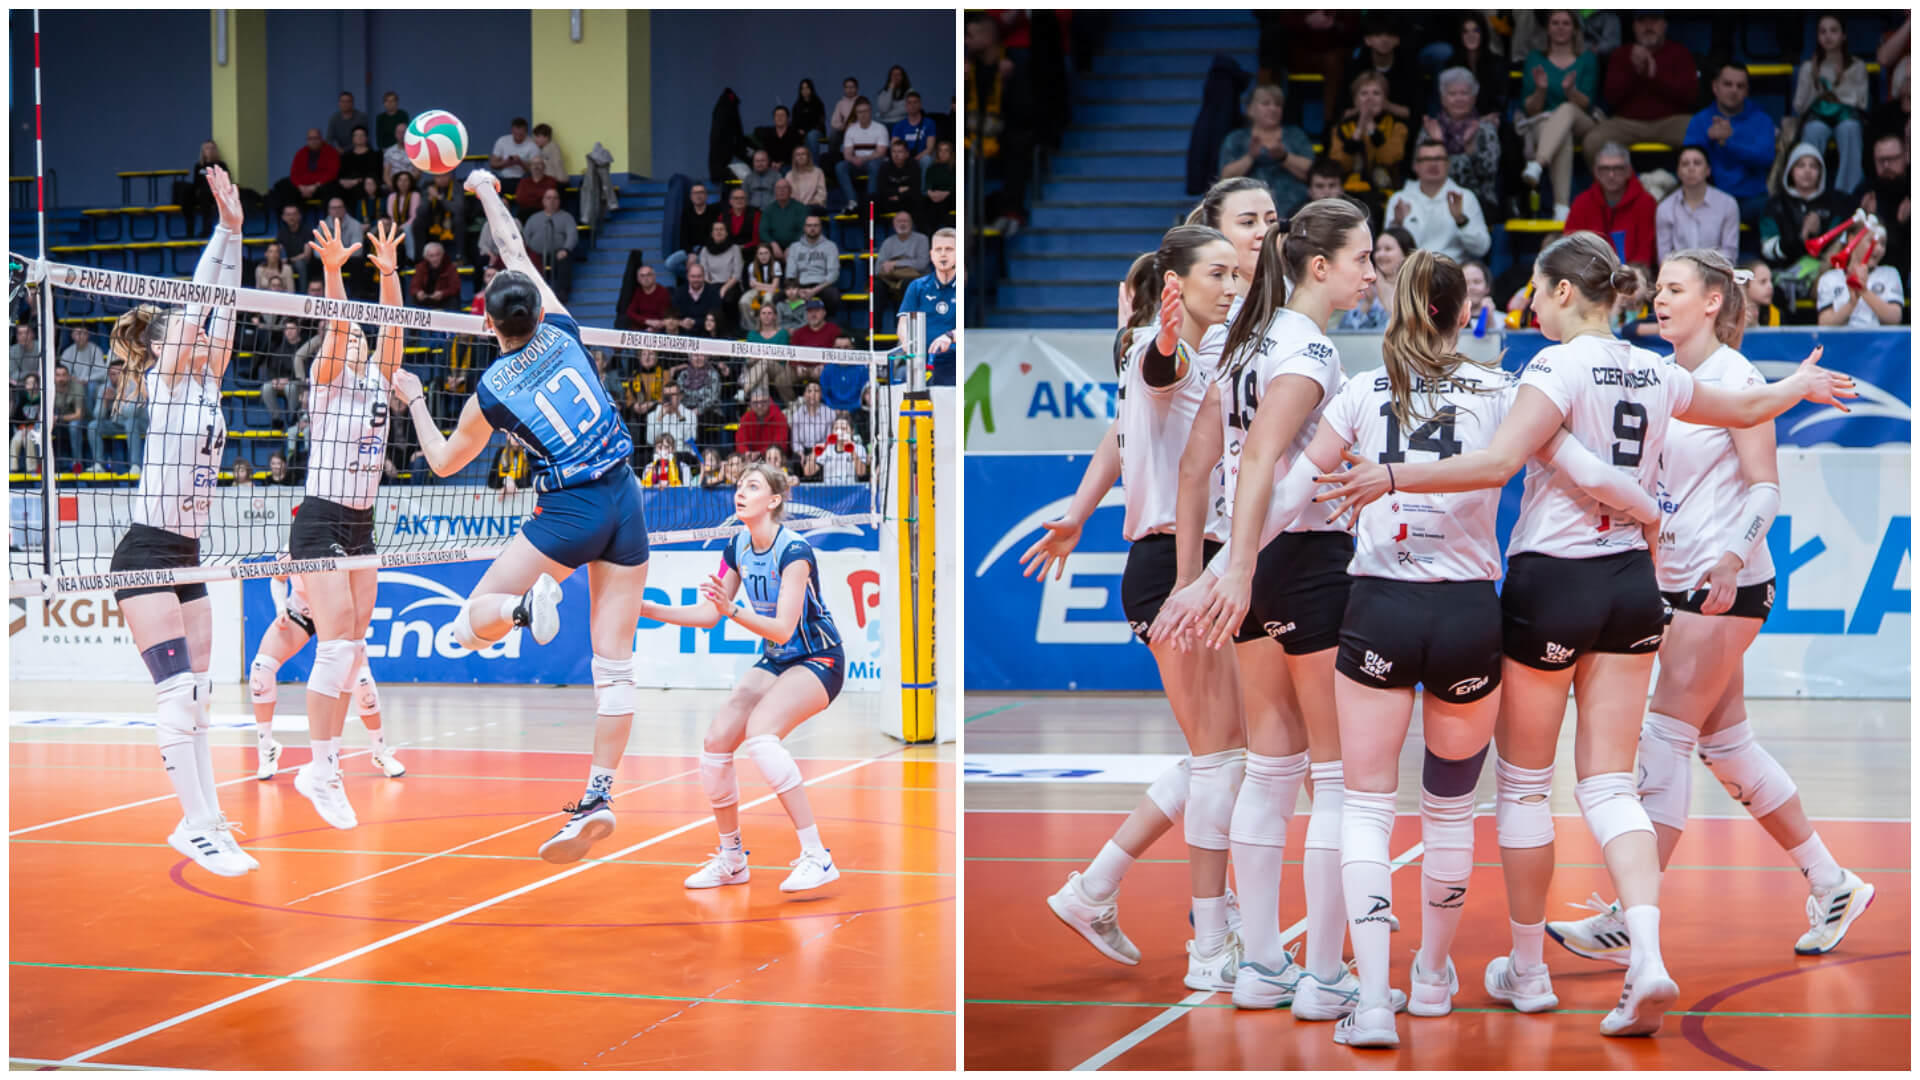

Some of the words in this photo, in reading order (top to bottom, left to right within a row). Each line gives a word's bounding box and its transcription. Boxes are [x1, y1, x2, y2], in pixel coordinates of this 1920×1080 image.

[79, 270, 112, 292] ENEA
[114, 274, 146, 295] KLUB
[149, 279, 212, 304] SIATKARSKI
[213, 287, 237, 307] PIŁA
[314, 299, 339, 316] ENEA
[340, 302, 364, 321] KLUB
[365, 305, 413, 325] SIATKARSKI
[414, 311, 432, 327] PIŁA
[534, 366, 601, 447] 13
[1229, 363, 1259, 432] 19
[370, 402, 388, 427] 9
[201, 424, 223, 456] 14
[1378, 400, 1463, 465] 14
[1612, 400, 1648, 467] 9
[394, 514, 521, 536] AKTYWNE
[79, 574, 103, 591] KLUB
[104, 572, 155, 589] SIATKARSKI
[156, 570, 176, 584] PIŁA
[239, 564, 260, 578] ENEA
[260, 563, 280, 576] KLUB
[280, 560, 320, 575] SIATKARSKI
[321, 559, 337, 571] PIŁA
[749, 574, 768, 601] 77
[43, 599, 125, 628] KGH
[632, 587, 764, 654] PIŁ
[43, 634, 103, 644] POLSKA
[113, 634, 137, 644] MI
[1455, 675, 1489, 696] Enea
